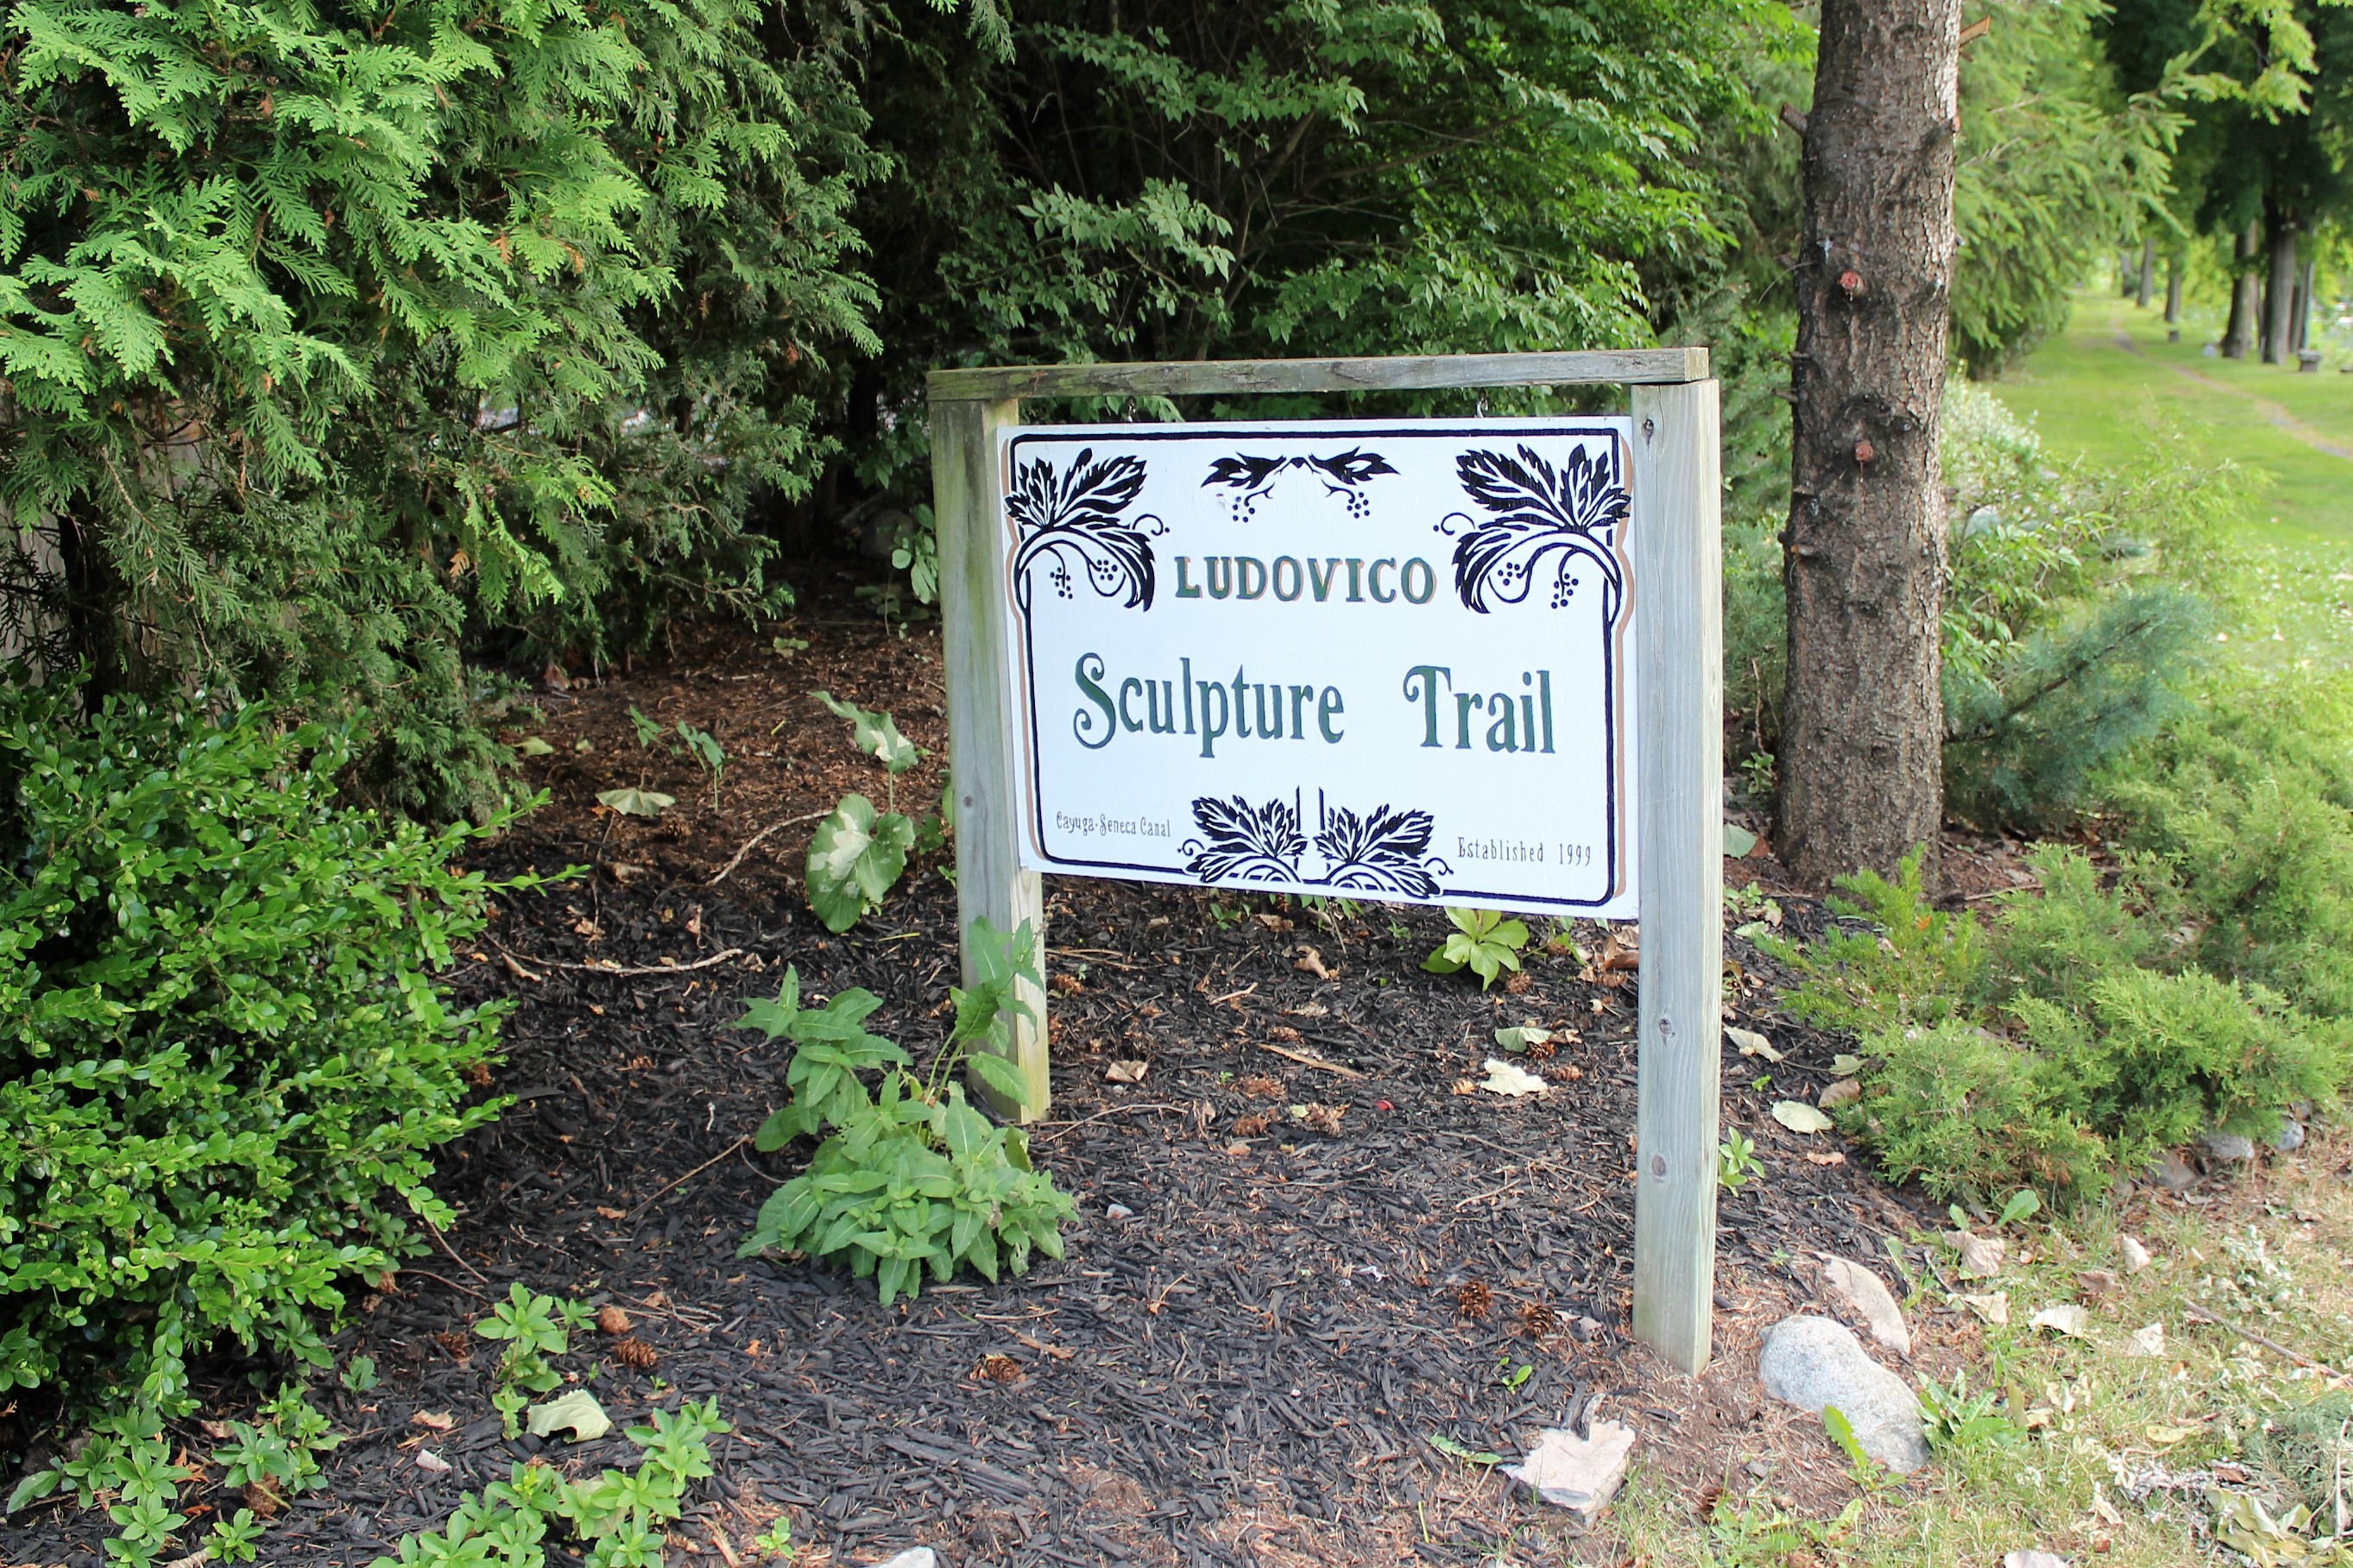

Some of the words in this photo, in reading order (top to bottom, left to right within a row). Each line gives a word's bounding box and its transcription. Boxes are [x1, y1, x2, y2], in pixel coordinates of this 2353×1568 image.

[1174, 555, 1437, 605] LUDOVICO
[1072, 652, 1345, 759] Sculpture
[1402, 664, 1556, 754] Trail
[1140, 816, 1170, 837] Canal
[1458, 836, 1543, 862] Established
[1560, 843, 1591, 866] 1999
